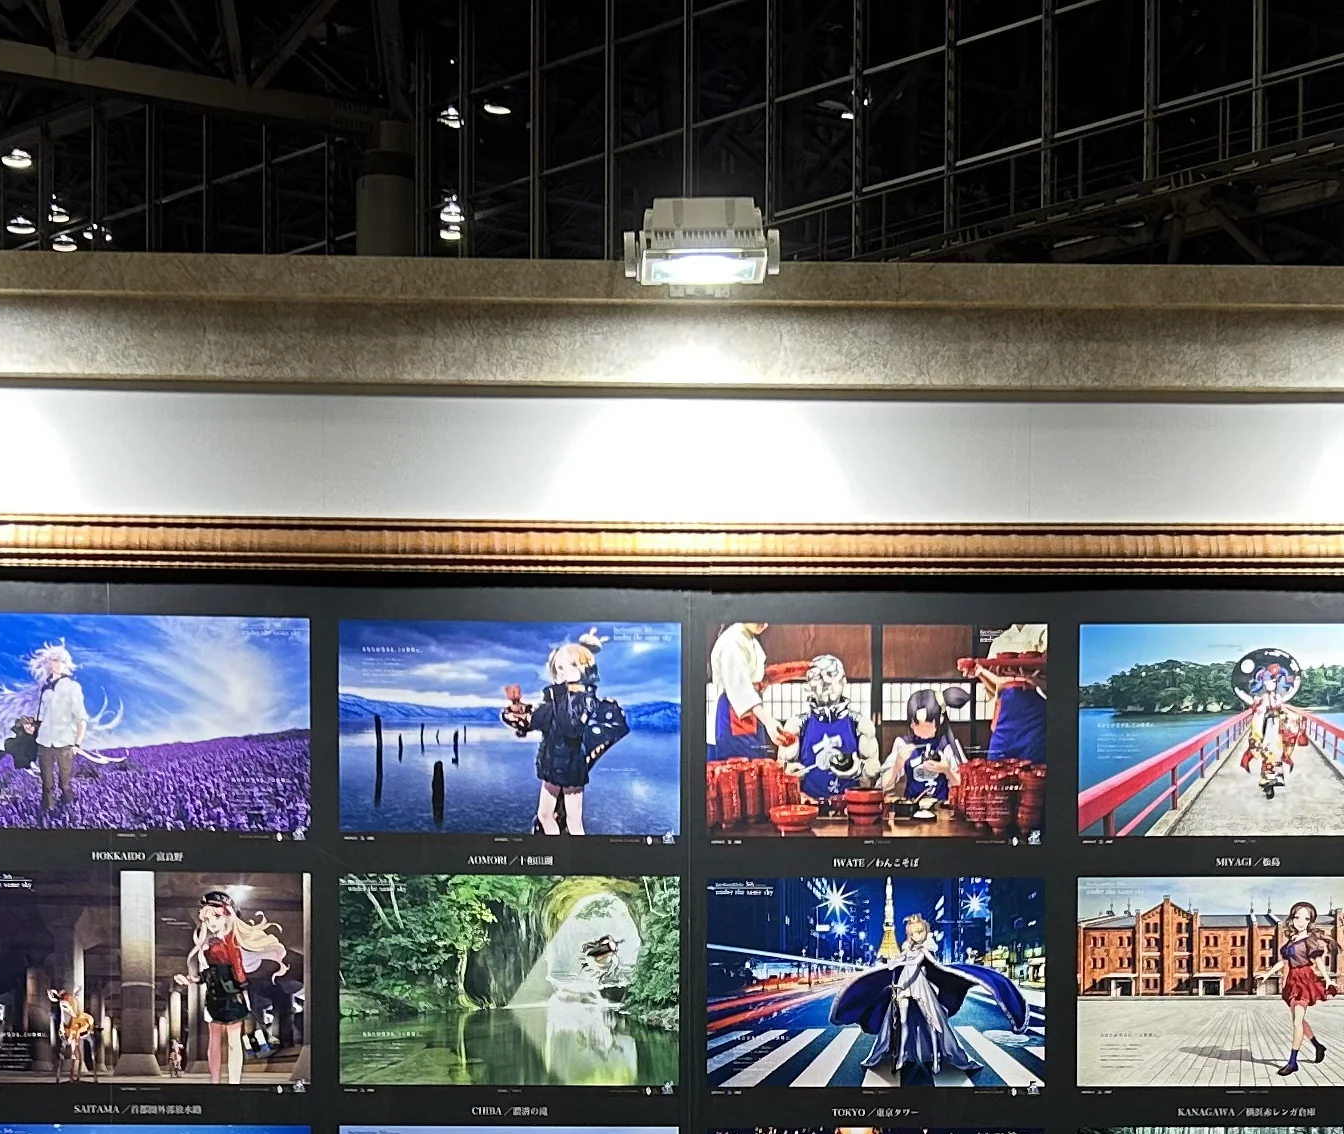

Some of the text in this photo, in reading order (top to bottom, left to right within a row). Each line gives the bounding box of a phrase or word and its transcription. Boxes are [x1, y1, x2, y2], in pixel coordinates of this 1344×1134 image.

[91, 851, 146, 861] HOKKAIDO
[467, 855, 509, 865] AOMORI
[833, 857, 920, 868] IWATE わんこそば
[1215, 857, 1252, 867] MIYAGI
[73, 1104, 120, 1114] SAITAMA
[471, 1106, 502, 1116] CHIBA
[831, 1107, 920, 1118] TOKYO 東京タワー
[1177, 1107, 1236, 1117] KANAGAWA
